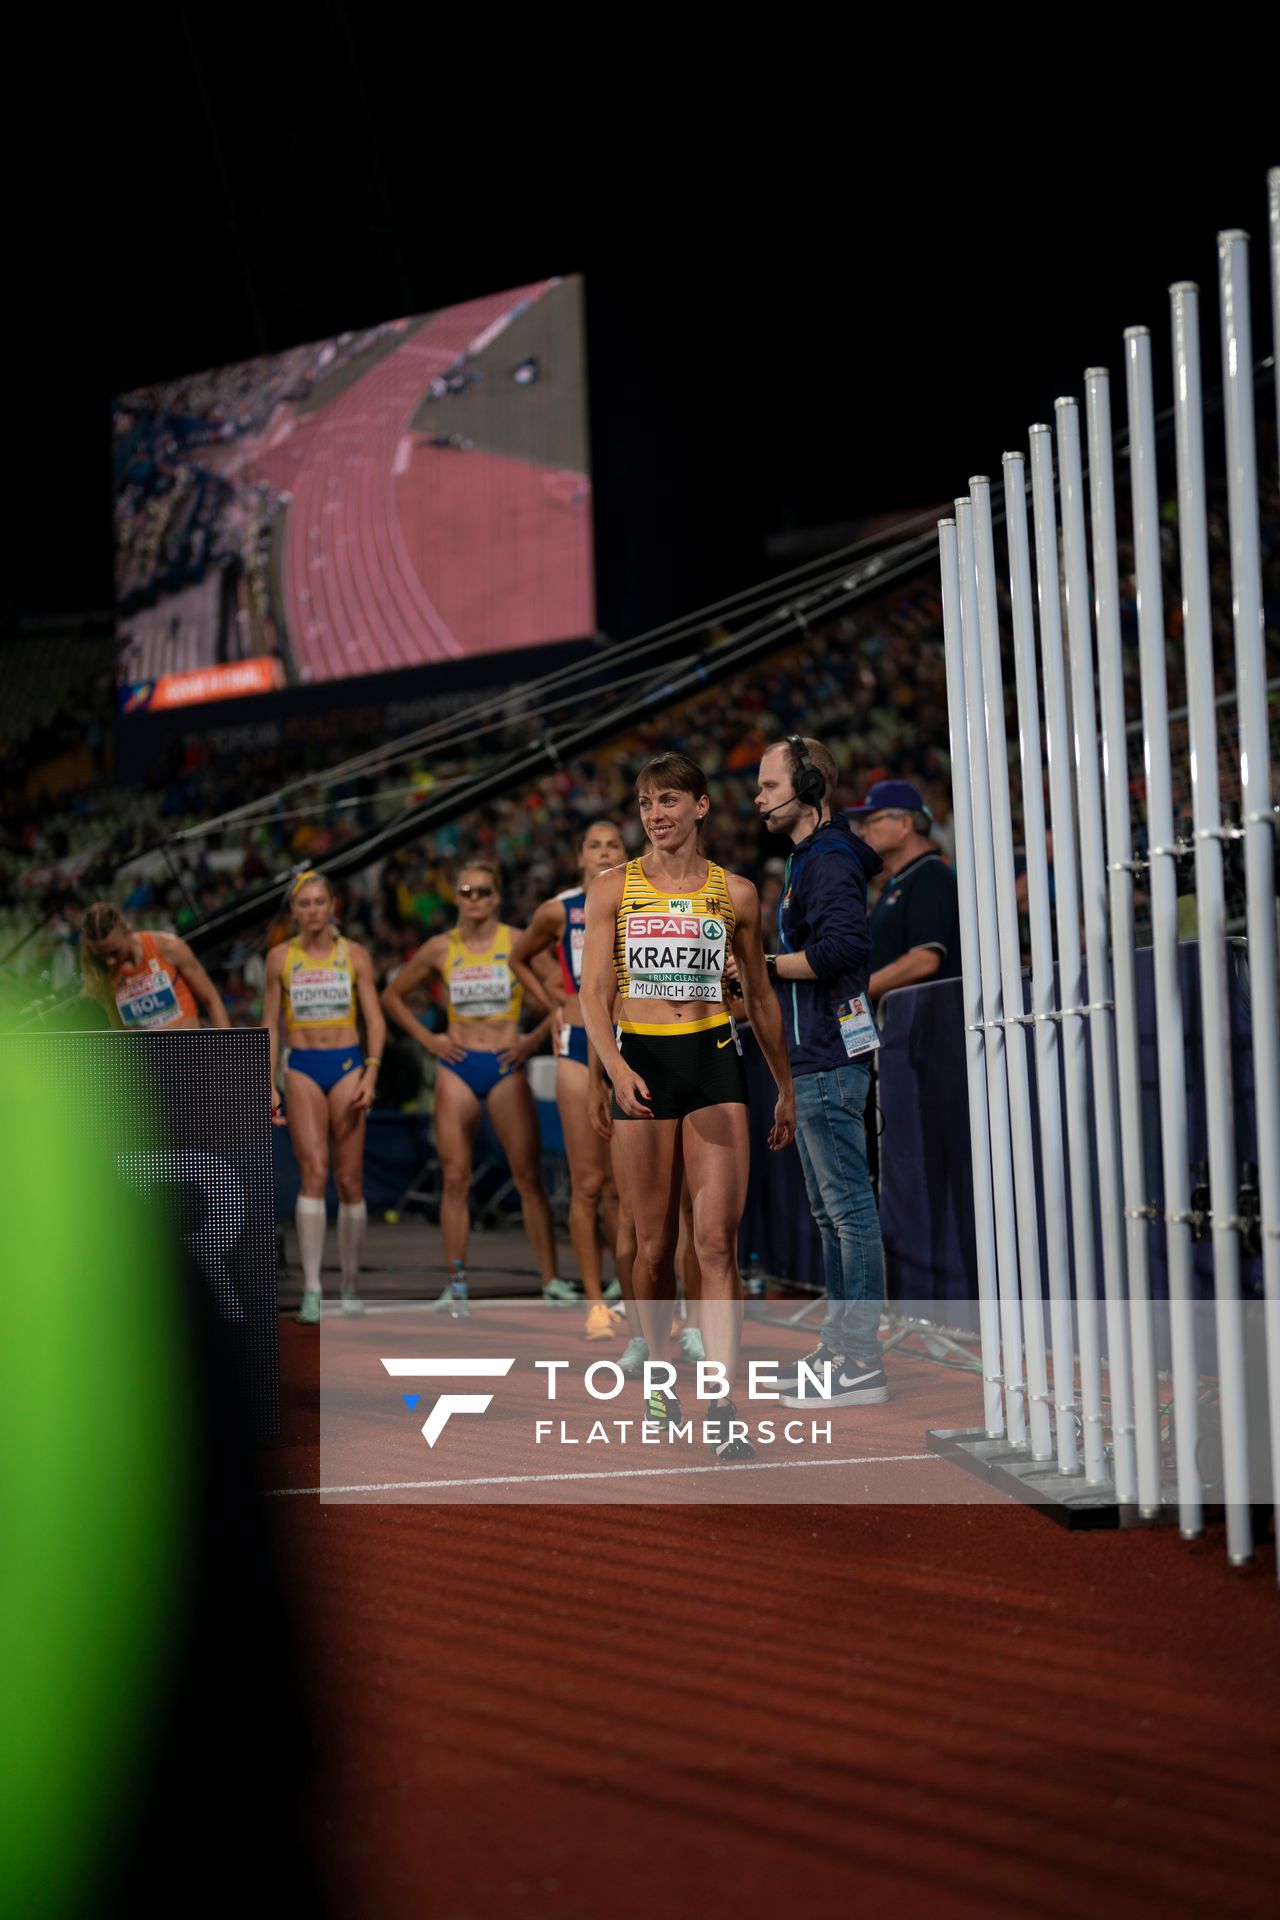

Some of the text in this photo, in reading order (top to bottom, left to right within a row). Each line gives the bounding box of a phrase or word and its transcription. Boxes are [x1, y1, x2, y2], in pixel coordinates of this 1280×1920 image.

[630, 919, 699, 935] SPAR
[629, 947, 721, 970] KRAFZIK
[654, 974, 672, 982] RUN
[674, 974, 699, 982] CLEAN
[634, 983, 717, 997] MUNICH 2022
[130, 994, 165, 1016] BOL
